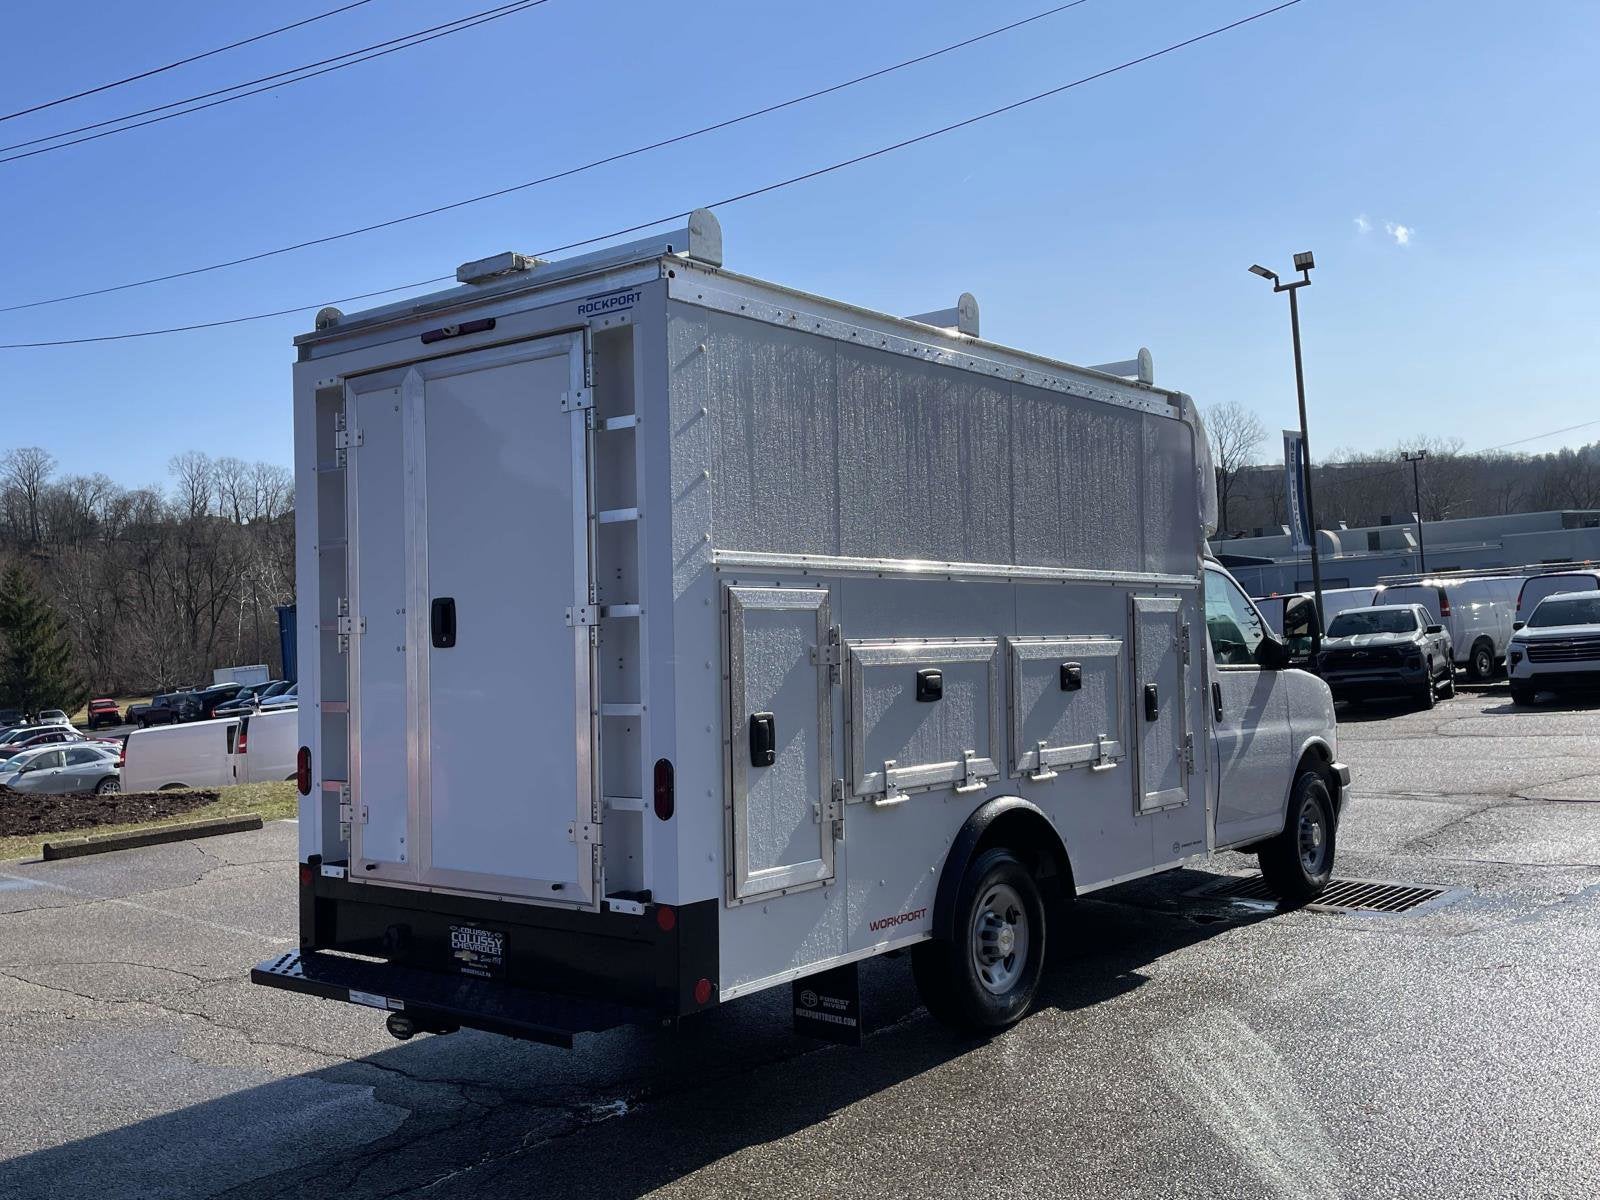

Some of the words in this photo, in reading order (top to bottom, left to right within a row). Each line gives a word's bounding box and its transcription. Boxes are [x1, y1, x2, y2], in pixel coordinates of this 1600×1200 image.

[577, 291, 642, 315] ROCKPORT
[1291, 479, 1304, 544] TRUCKS
[869, 908, 927, 932] WORKPORT
[451, 931, 503, 948] COLUSSY
[451, 941, 503, 956] CHEVROLET
